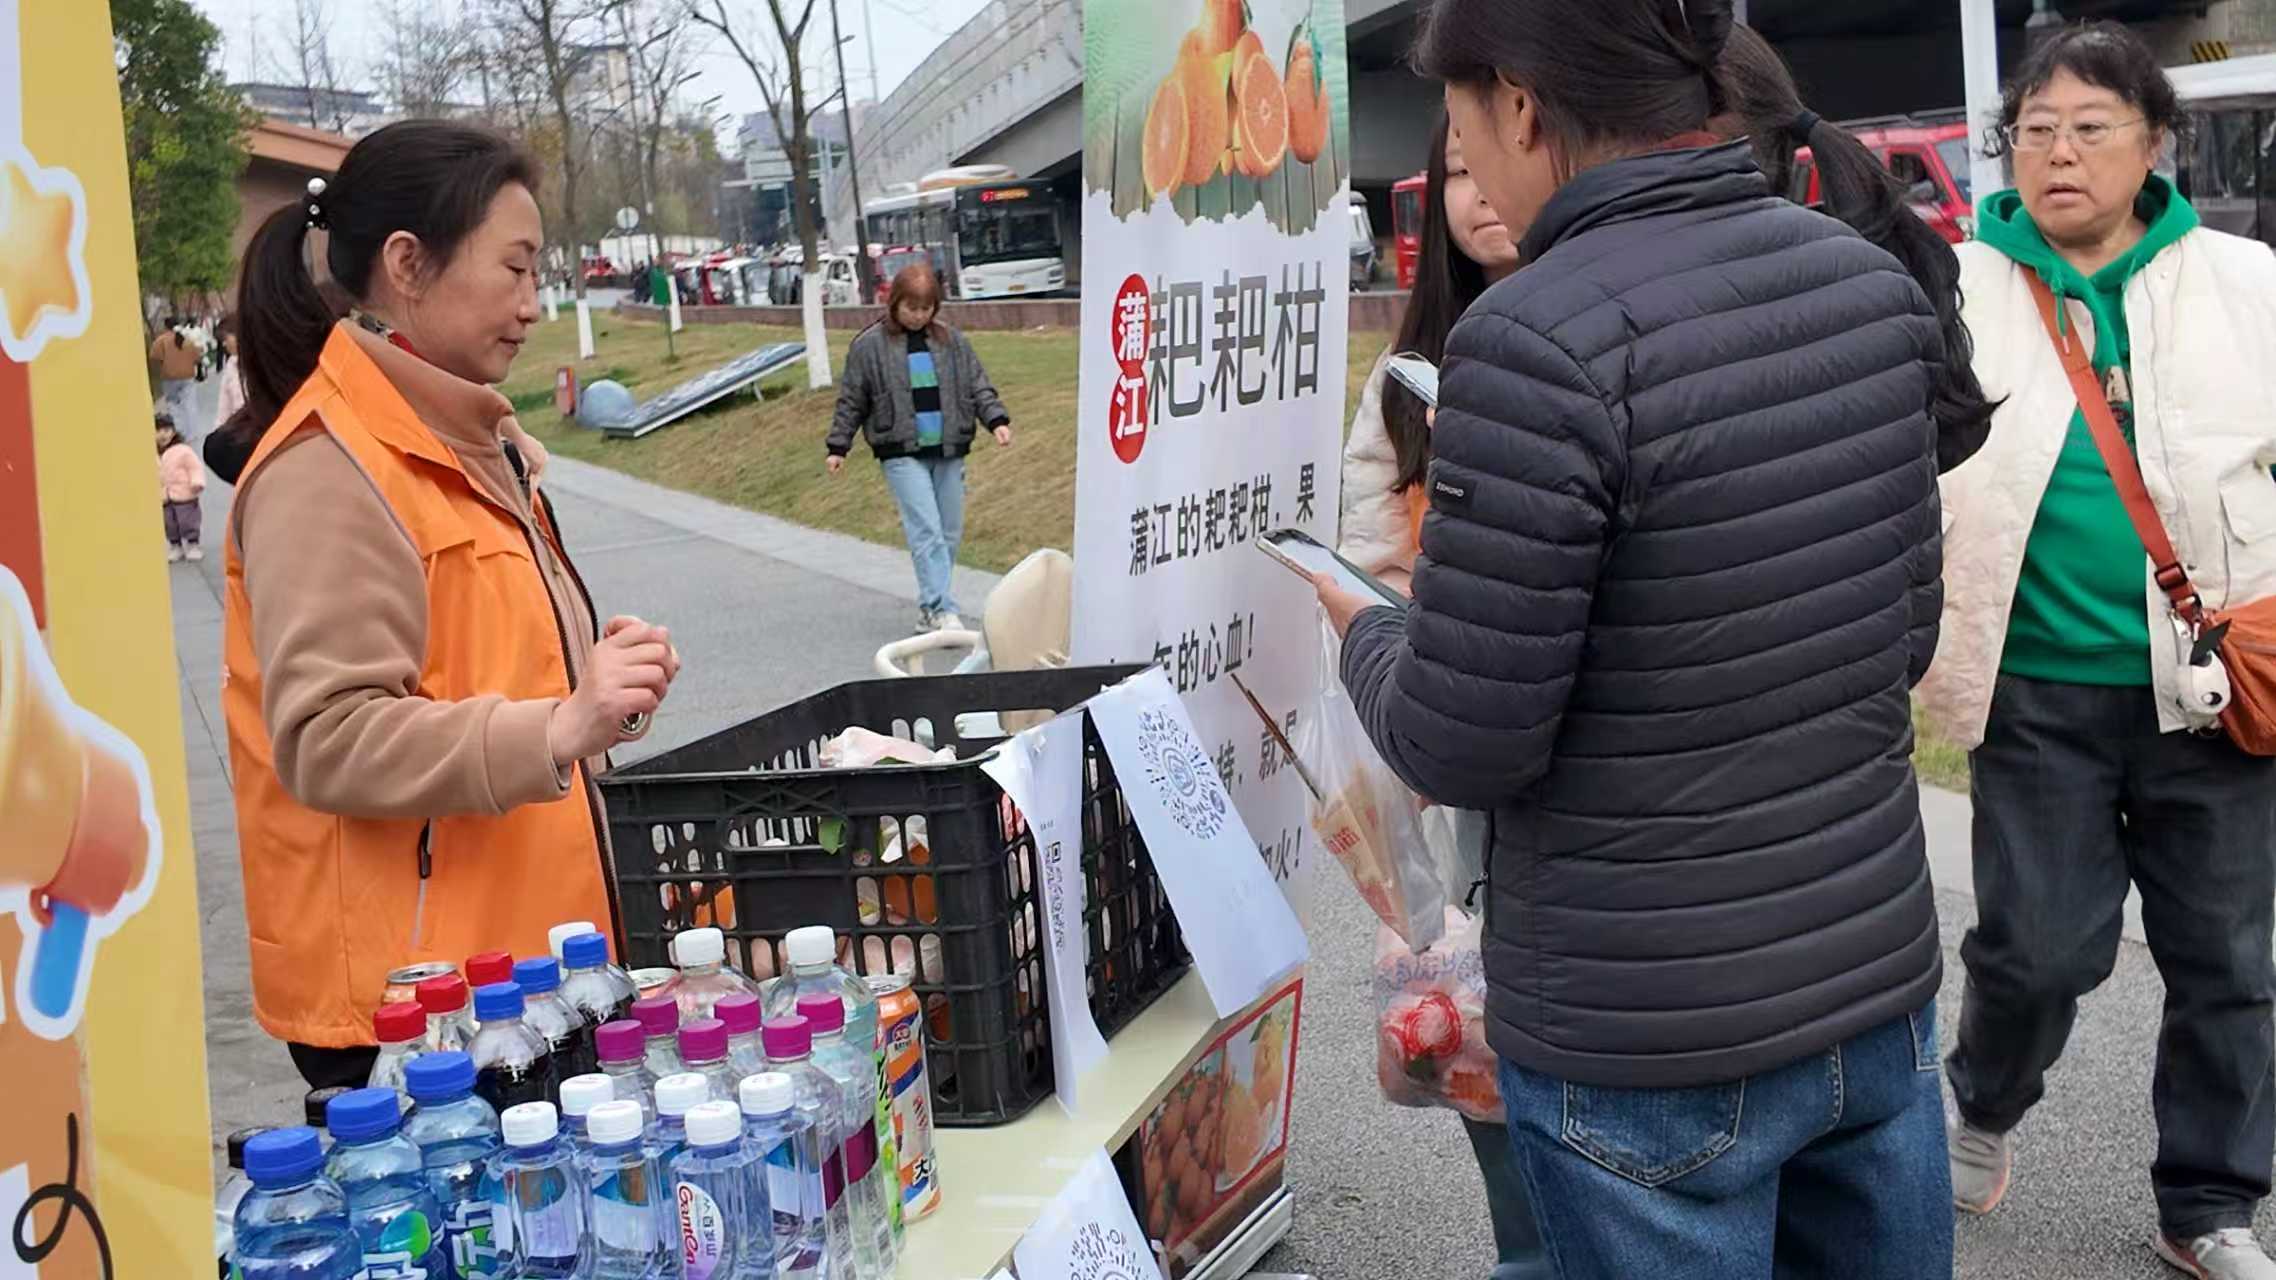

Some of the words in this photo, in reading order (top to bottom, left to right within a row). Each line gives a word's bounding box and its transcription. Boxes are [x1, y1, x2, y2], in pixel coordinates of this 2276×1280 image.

[1115, 291, 1147, 440] 蒲江
[1147, 260, 1326, 426] 耙耙柑
